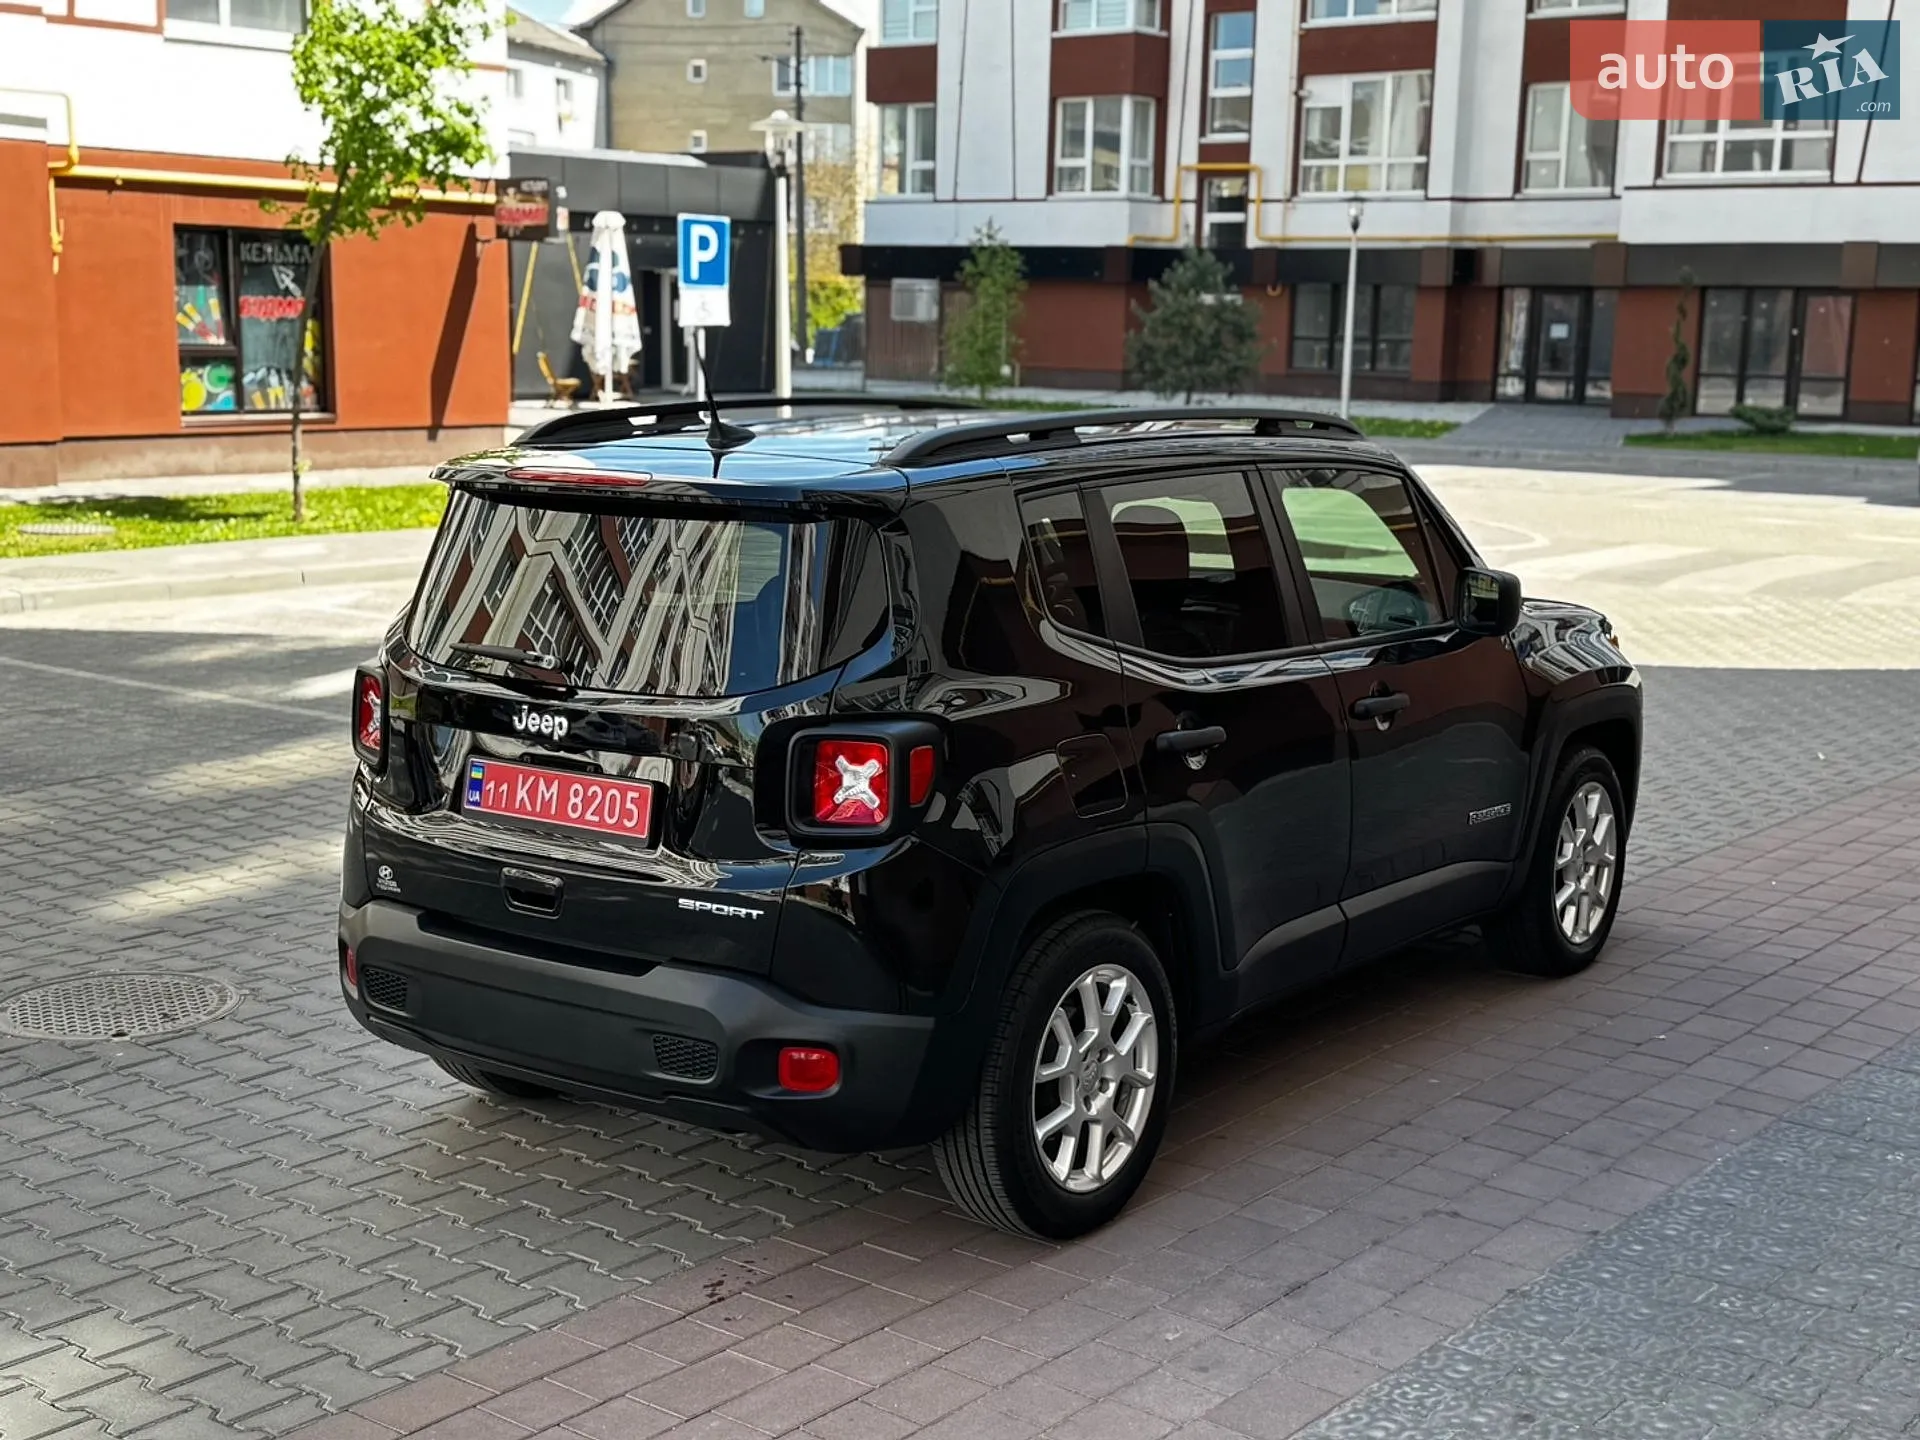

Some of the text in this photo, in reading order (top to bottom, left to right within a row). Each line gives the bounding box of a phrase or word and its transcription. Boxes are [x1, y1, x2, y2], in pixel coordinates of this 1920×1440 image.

[690, 223, 719, 281] P
[512, 705, 569, 741] Jeep
[468, 790, 480, 802] UA
[485, 773, 640, 828] 11 KM 8205
[678, 898, 765, 920] SPORT
